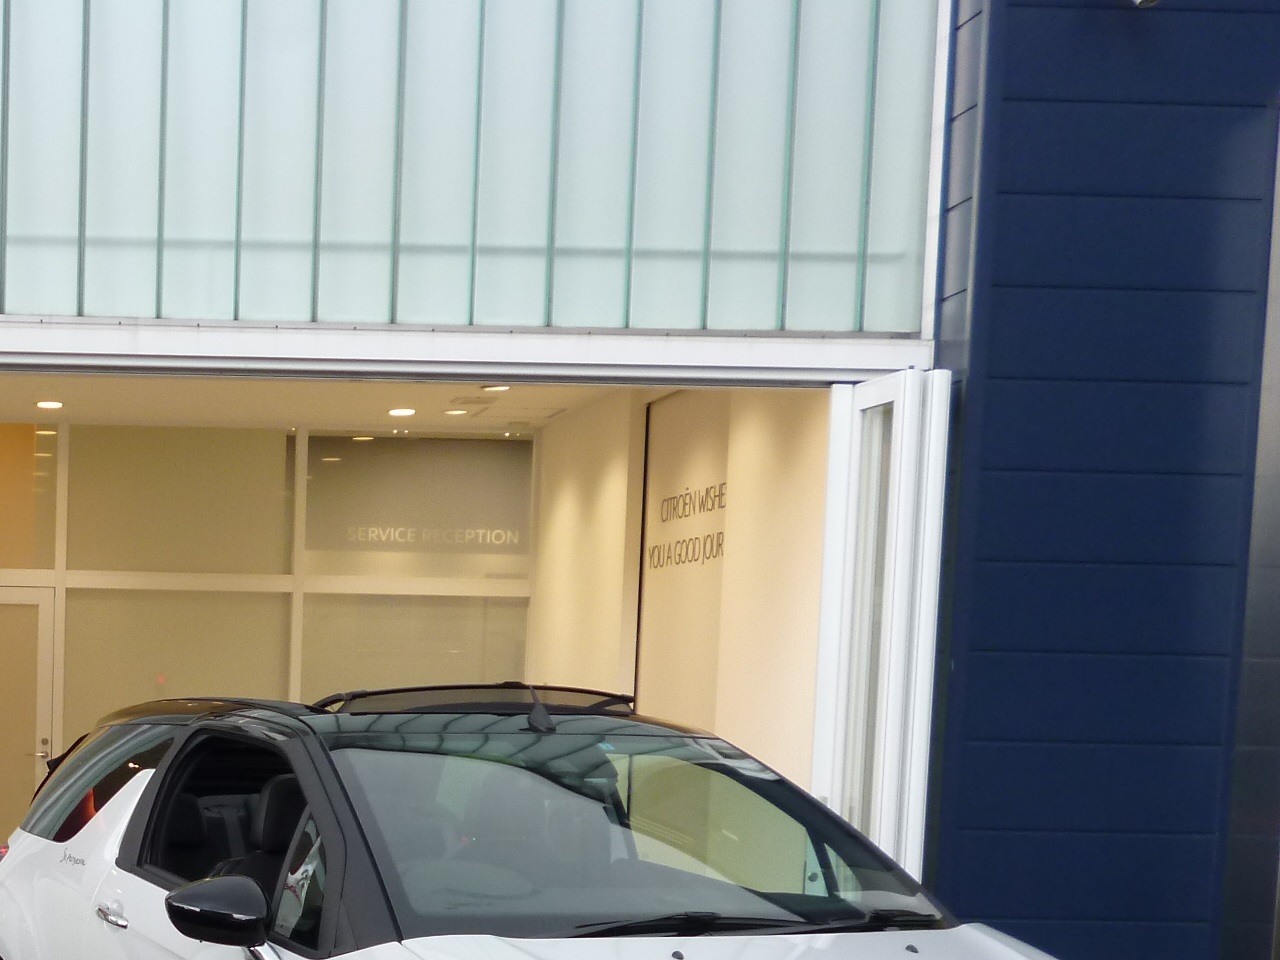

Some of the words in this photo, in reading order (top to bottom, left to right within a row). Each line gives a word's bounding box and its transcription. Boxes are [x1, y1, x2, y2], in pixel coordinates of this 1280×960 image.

[660, 487, 696, 523] CITROËN
[347, 526, 417, 543] SERVICE
[422, 528, 519, 545] RECEPTION
[648, 543, 666, 569] YOU
[666, 542, 673, 567] A
[674, 536, 701, 565] GOOD
